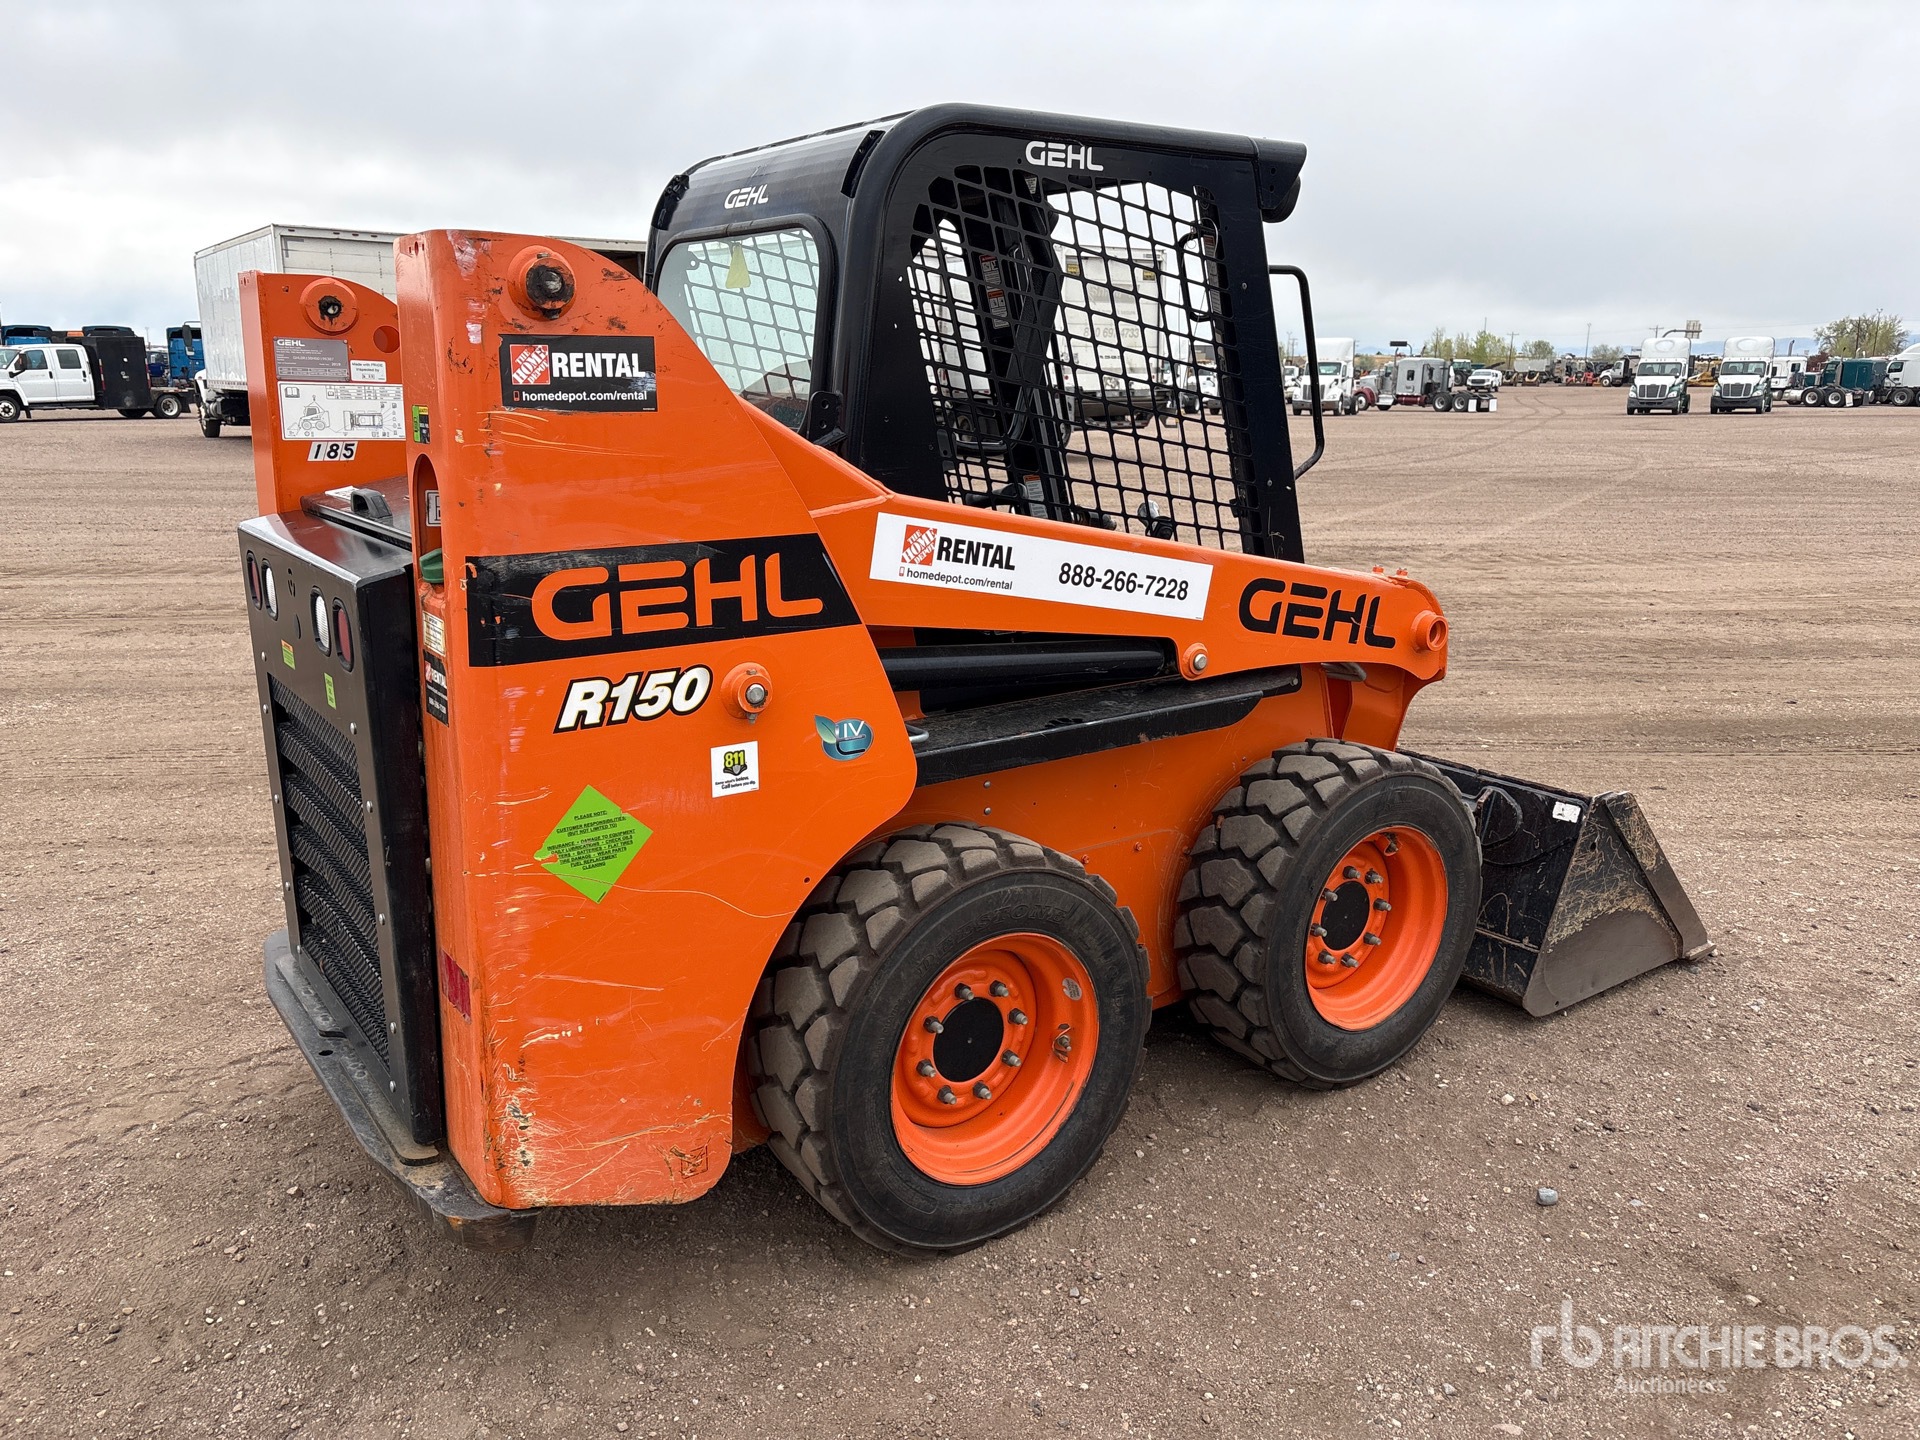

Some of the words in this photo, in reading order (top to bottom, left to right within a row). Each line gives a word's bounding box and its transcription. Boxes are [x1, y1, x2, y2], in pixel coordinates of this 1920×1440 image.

[1025, 140, 1104, 172] GEHL
[724, 184, 768, 210] GEHL
[512, 344, 549, 384] HOME
[515, 348, 531, 366] THE
[551, 352, 646, 378] RENTAL
[527, 360, 549, 384] DEPOT
[522, 390, 647, 403] homedepot.com/rental
[314, 443, 355, 460] 185
[902, 527, 938, 564] HOME
[907, 528, 922, 544] THE
[914, 542, 936, 564] DEPOT
[936, 536, 1016, 571] RENTAL
[906, 568, 1013, 590] homedepot.com/rental
[1058, 562, 1189, 601] 888-266-7228
[531, 552, 824, 641] GEHL
[1238, 576, 1396, 650] GEHL
[555, 665, 712, 732] R150
[724, 750, 745, 768] 811
[556, 824, 582, 833] CUSTOMER
[547, 842, 575, 851] INSURANCE
[609, 829, 635, 839] EQUIPMENT
[577, 846, 602, 855] BATTERIES
[571, 853, 592, 862] DAMAGE
[582, 862, 606, 870] CLEANING
[584, 854, 617, 865] REPLACEMENT
